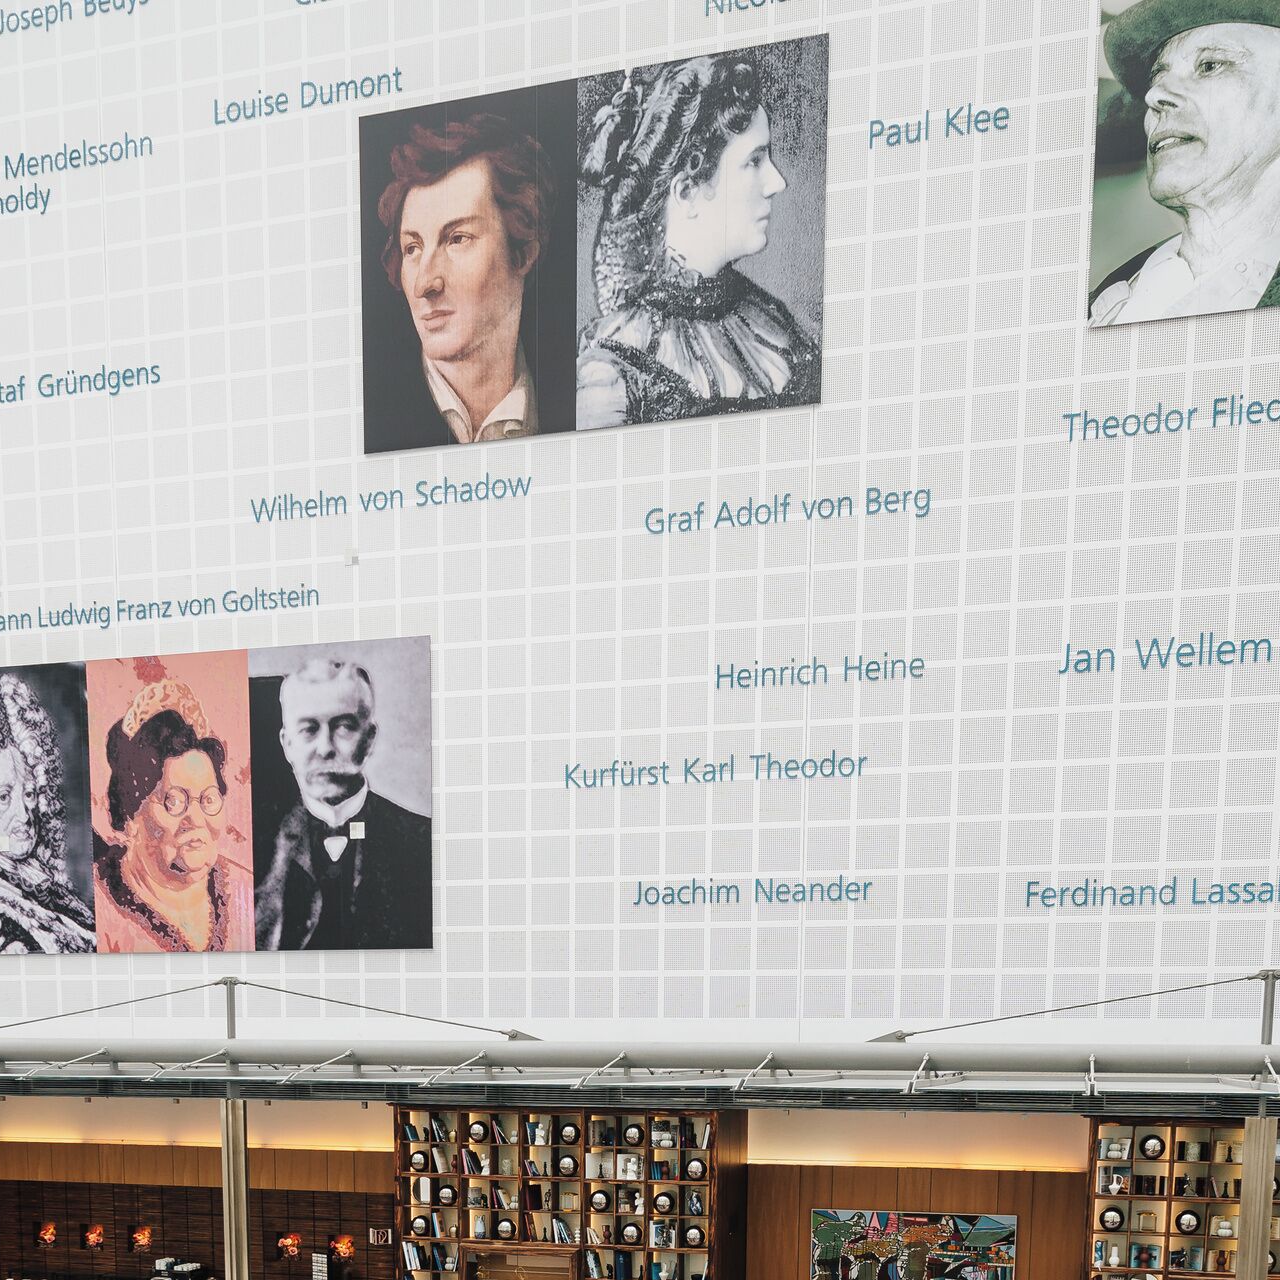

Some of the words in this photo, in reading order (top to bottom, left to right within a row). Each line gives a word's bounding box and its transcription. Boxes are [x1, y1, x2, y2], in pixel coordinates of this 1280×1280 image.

[213, 91, 289, 126] Louise
[300, 67, 401, 110] Dumont
[868, 111, 930, 149] Paul
[944, 102, 1010, 137] Klee
[3, 133, 153, 178] Mendelssohn
[36, 364, 162, 399] Gründgens
[1061, 403, 1199, 443] Theodor
[250, 490, 348, 524] Wilhelm
[359, 489, 404, 513] von
[415, 474, 532, 508] Schadow
[644, 500, 704, 535] Graf
[713, 492, 791, 528] Adolf
[801, 495, 854, 520] von
[865, 486, 932, 519] Berg
[37, 606, 112, 630] Ludwig
[116, 599, 173, 621] Franz
[177, 597, 217, 617] von
[222, 585, 320, 614] Goltstein
[715, 655, 829, 690] Heinrich
[843, 655, 926, 683] Heine
[1057, 642, 1116, 676] Jan
[1134, 631, 1273, 670] Wellem
[564, 759, 669, 789] Kurfürst
[683, 754, 735, 784] Karl
[751, 750, 868, 781] Theodor
[634, 879, 741, 907] Joachim
[754, 874, 872, 905] Neander
[1025, 876, 1178, 908] Ferdinand
